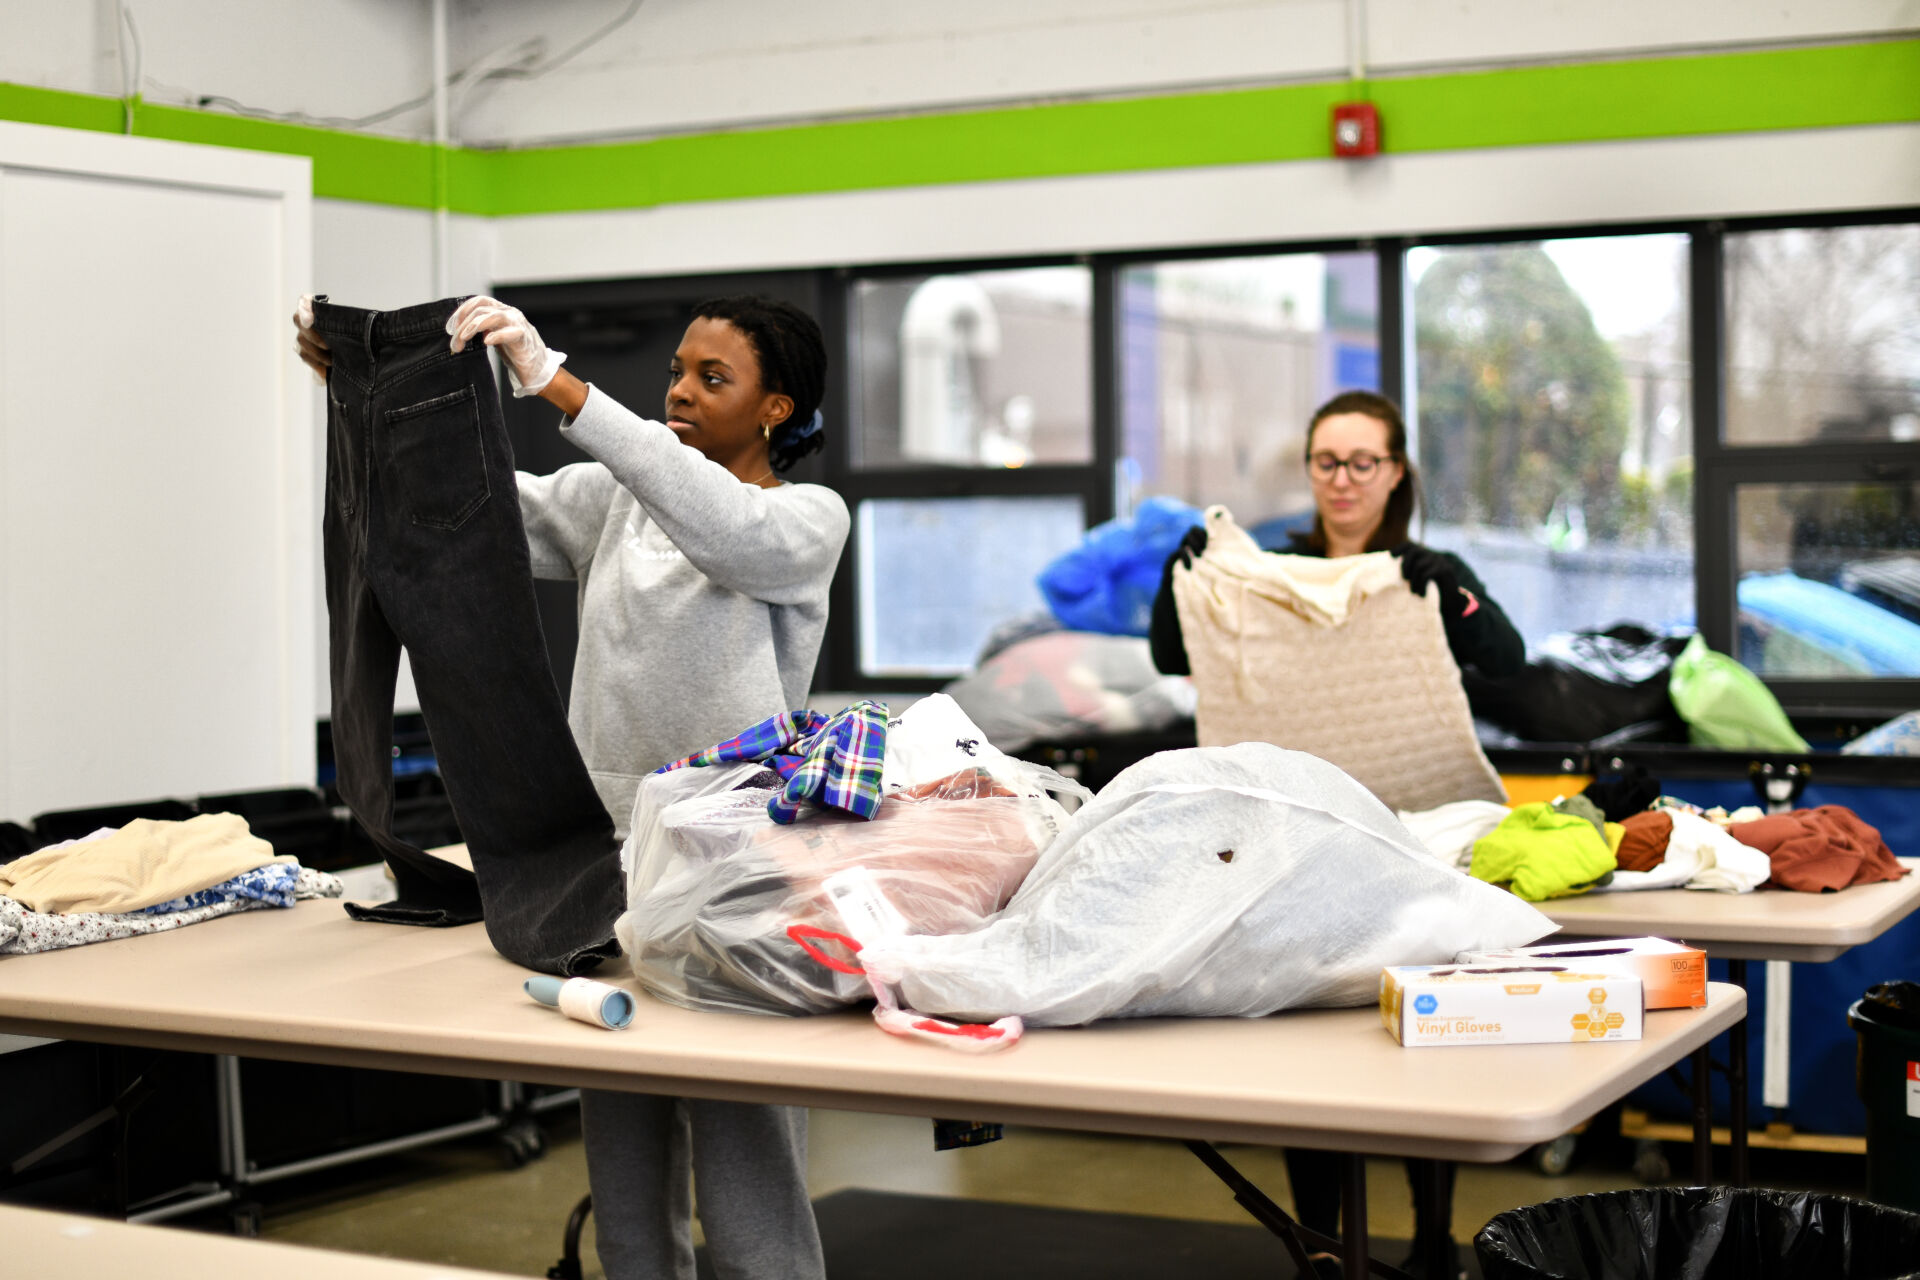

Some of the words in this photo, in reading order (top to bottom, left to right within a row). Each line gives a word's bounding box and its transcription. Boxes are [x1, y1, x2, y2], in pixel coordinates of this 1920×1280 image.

[1672, 960, 1688, 970] 100
[1416, 1021, 1451, 1036] Vinyl
[1455, 1021, 1502, 1034] Gloves
